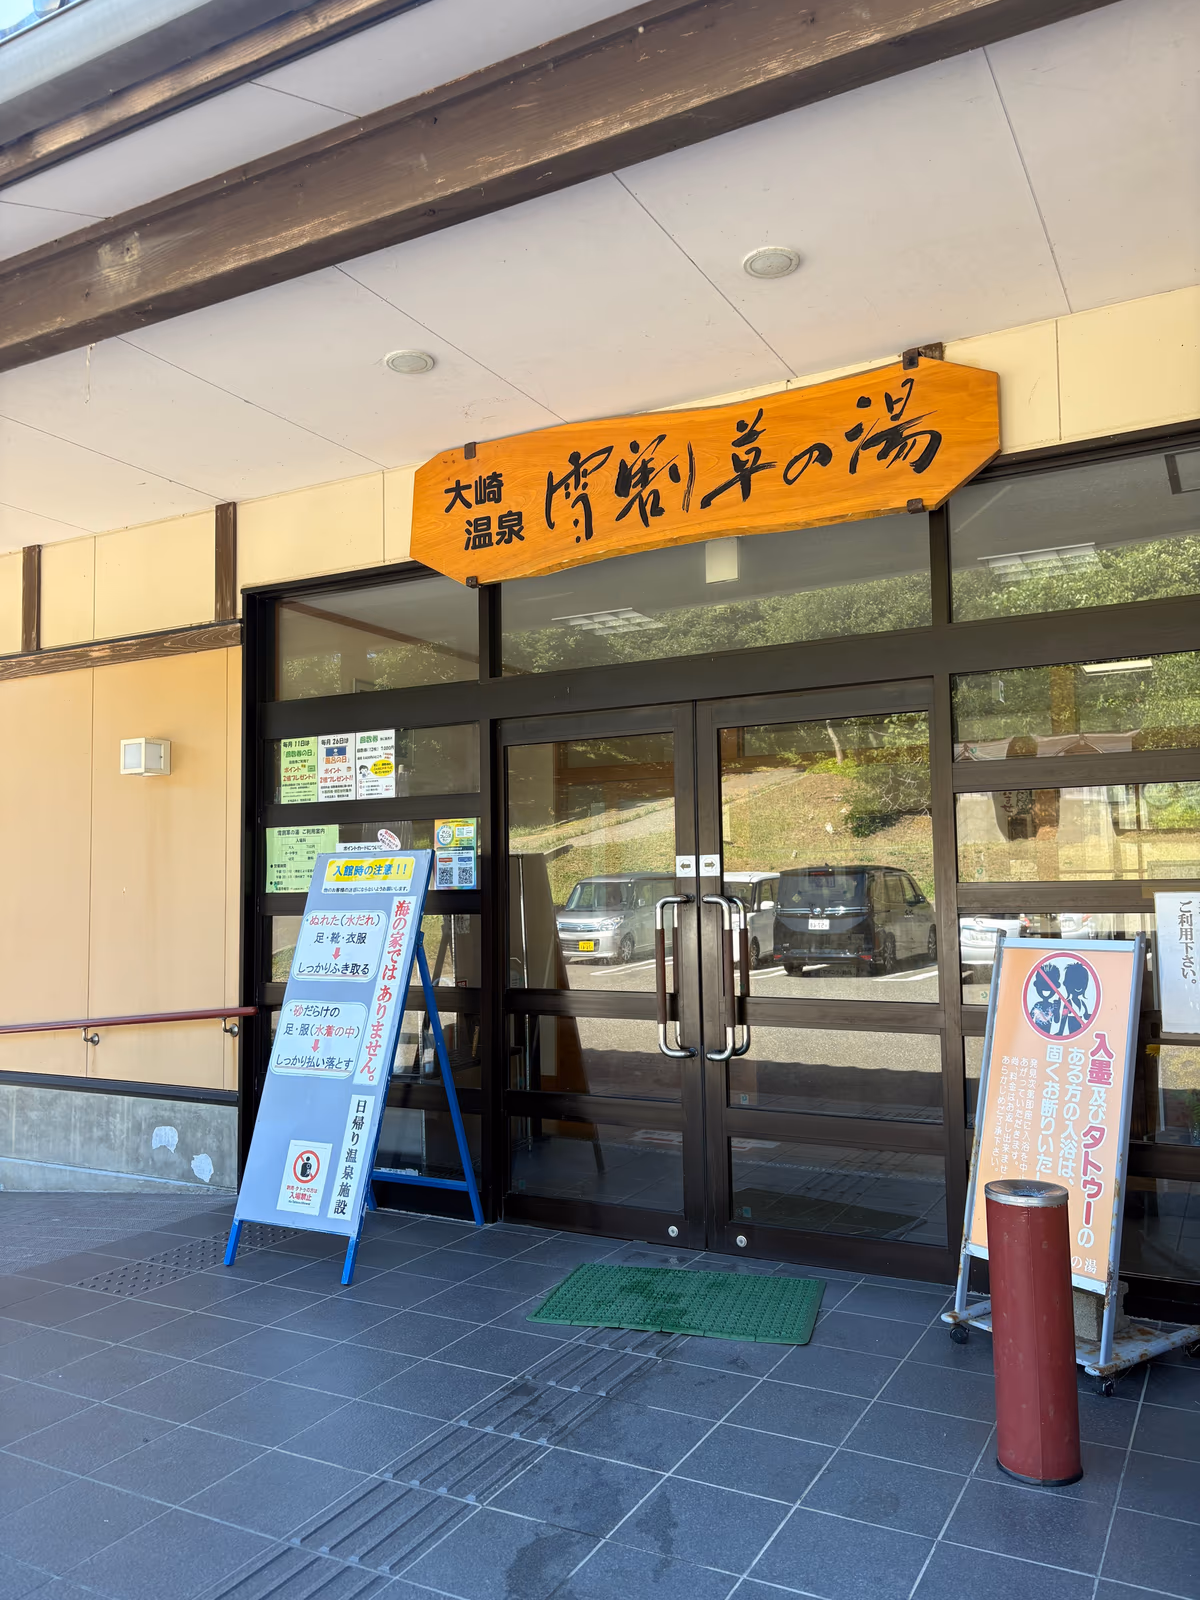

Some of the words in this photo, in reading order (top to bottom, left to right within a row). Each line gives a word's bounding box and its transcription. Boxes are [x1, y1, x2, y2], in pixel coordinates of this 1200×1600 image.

[444, 471, 504, 514] 大崎
[464, 510, 526, 551] 温泉
[298, 961, 370, 976] しっかりふき取る
[314, 932, 367, 945] 足・靴・衣服
[1178, 900, 1197, 984] ご利用下さい。
[276, 1054, 354, 1070] しっかり払い落とす
[333, 1099, 367, 1216] 日帰り温泉施設
[991, 1055, 1010, 1172] あらかじめご了承下さい。
[999, 1056, 1019, 1180] 尚、料金はお返し出来ませ
[1011, 1057, 1029, 1166] あがっていただきます。
[1057, 1046, 1085, 1186] ある方の入浴は、
[1077, 1031, 1116, 1248] 入墨及びタトゥーの
